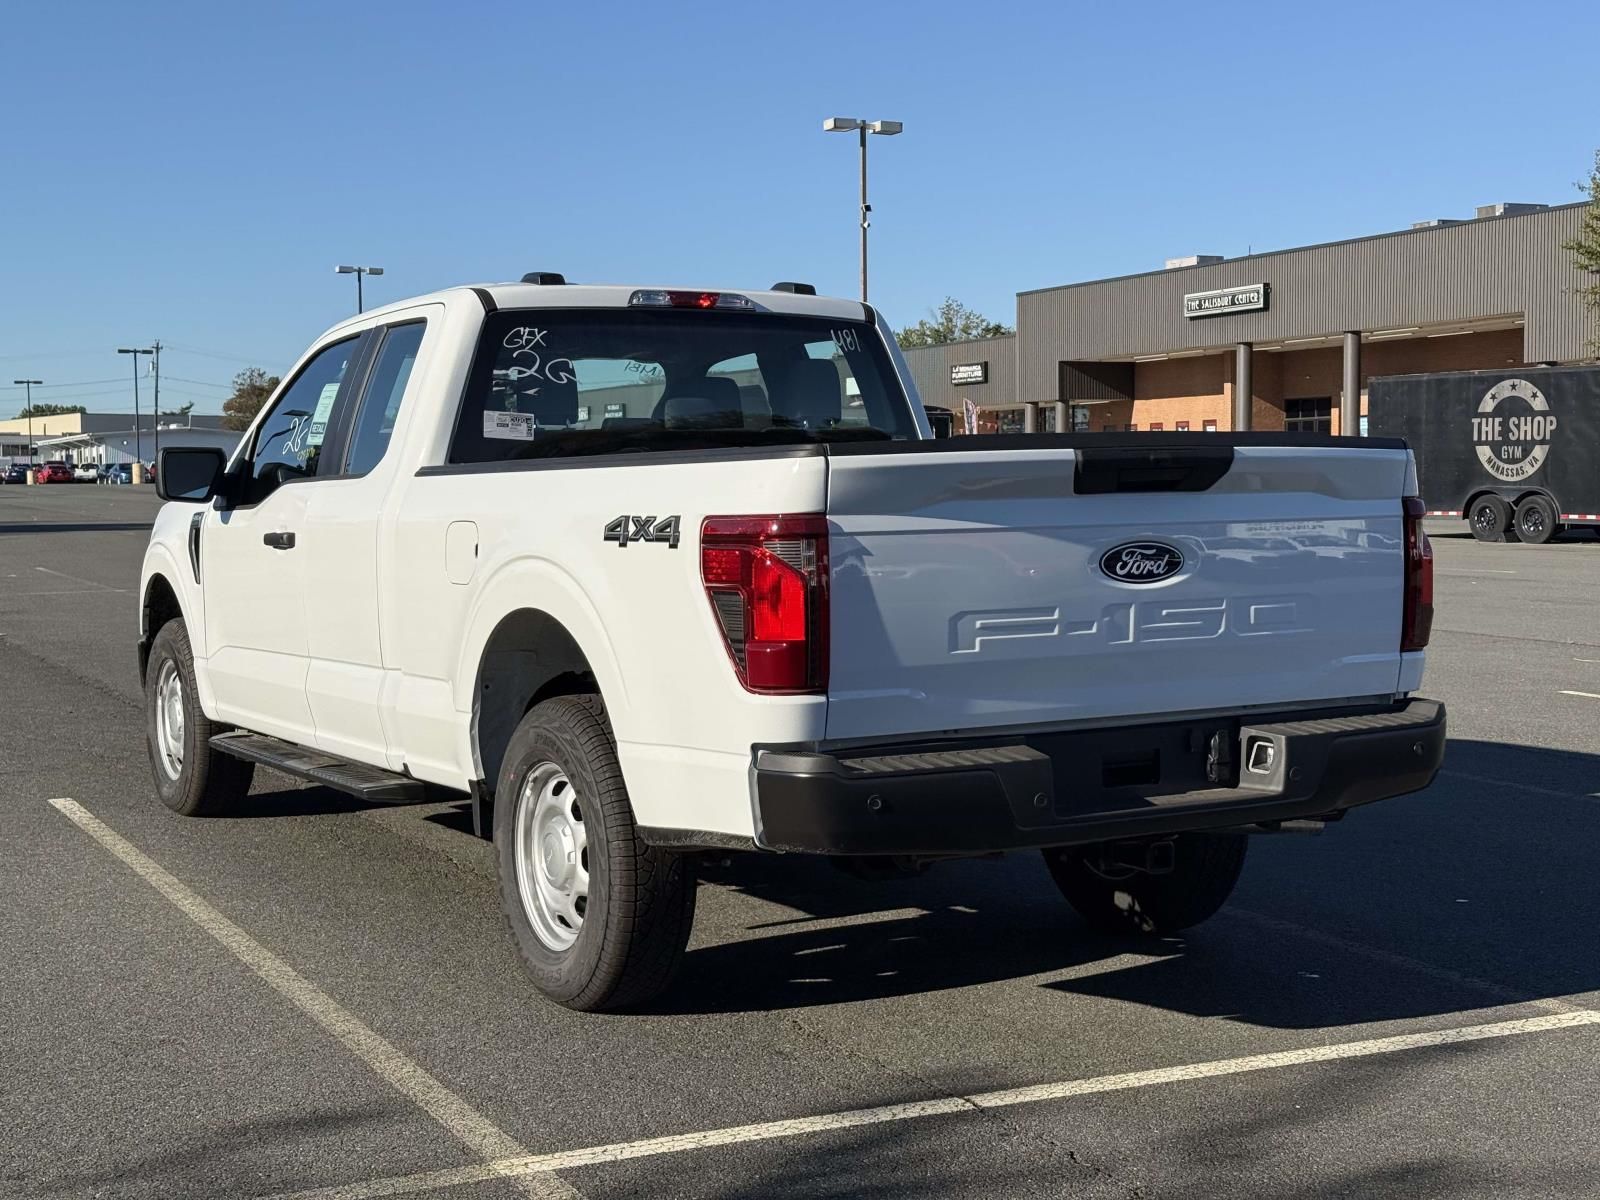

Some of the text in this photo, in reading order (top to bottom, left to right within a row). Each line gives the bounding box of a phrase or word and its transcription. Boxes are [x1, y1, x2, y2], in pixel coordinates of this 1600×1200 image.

[1188, 292, 1258, 311] THE SALISBURY CENTER
[503, 327, 548, 350] GFX
[1471, 415, 1557, 441] THE SHOP
[1501, 445, 1522, 459] GYM
[1485, 455, 1540, 478] MANASSAS, VA
[1116, 548, 1169, 576] Ford
